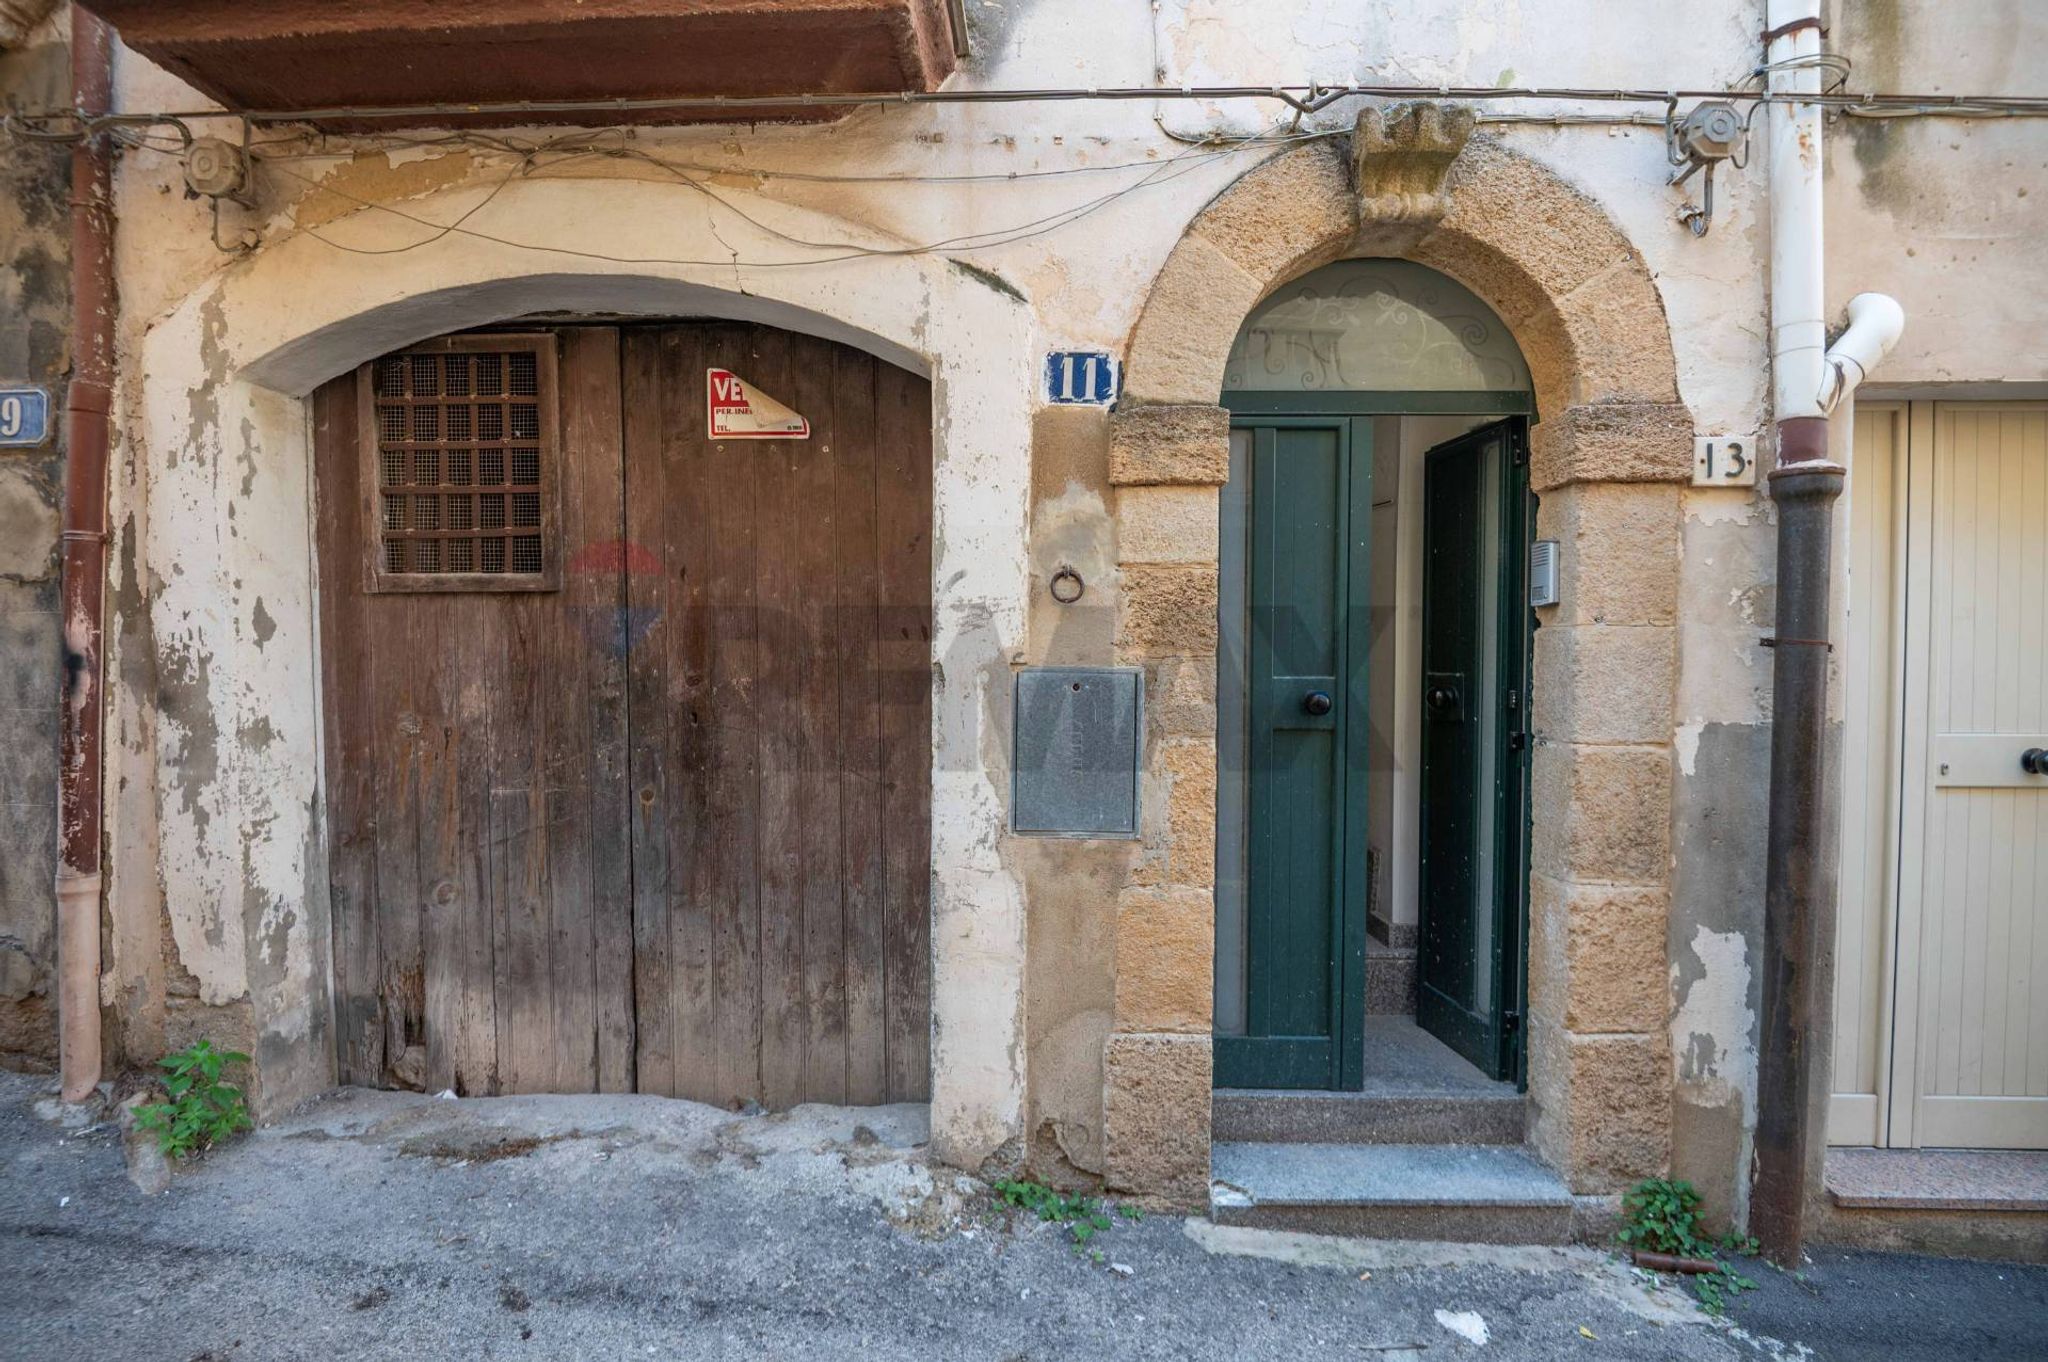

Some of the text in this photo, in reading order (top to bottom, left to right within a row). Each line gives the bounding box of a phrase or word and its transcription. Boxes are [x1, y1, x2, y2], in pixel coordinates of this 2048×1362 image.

[1060, 357, 1097, 401] 11
[1, 397, 21, 436] 9
[1706, 442, 1746, 479] 13
